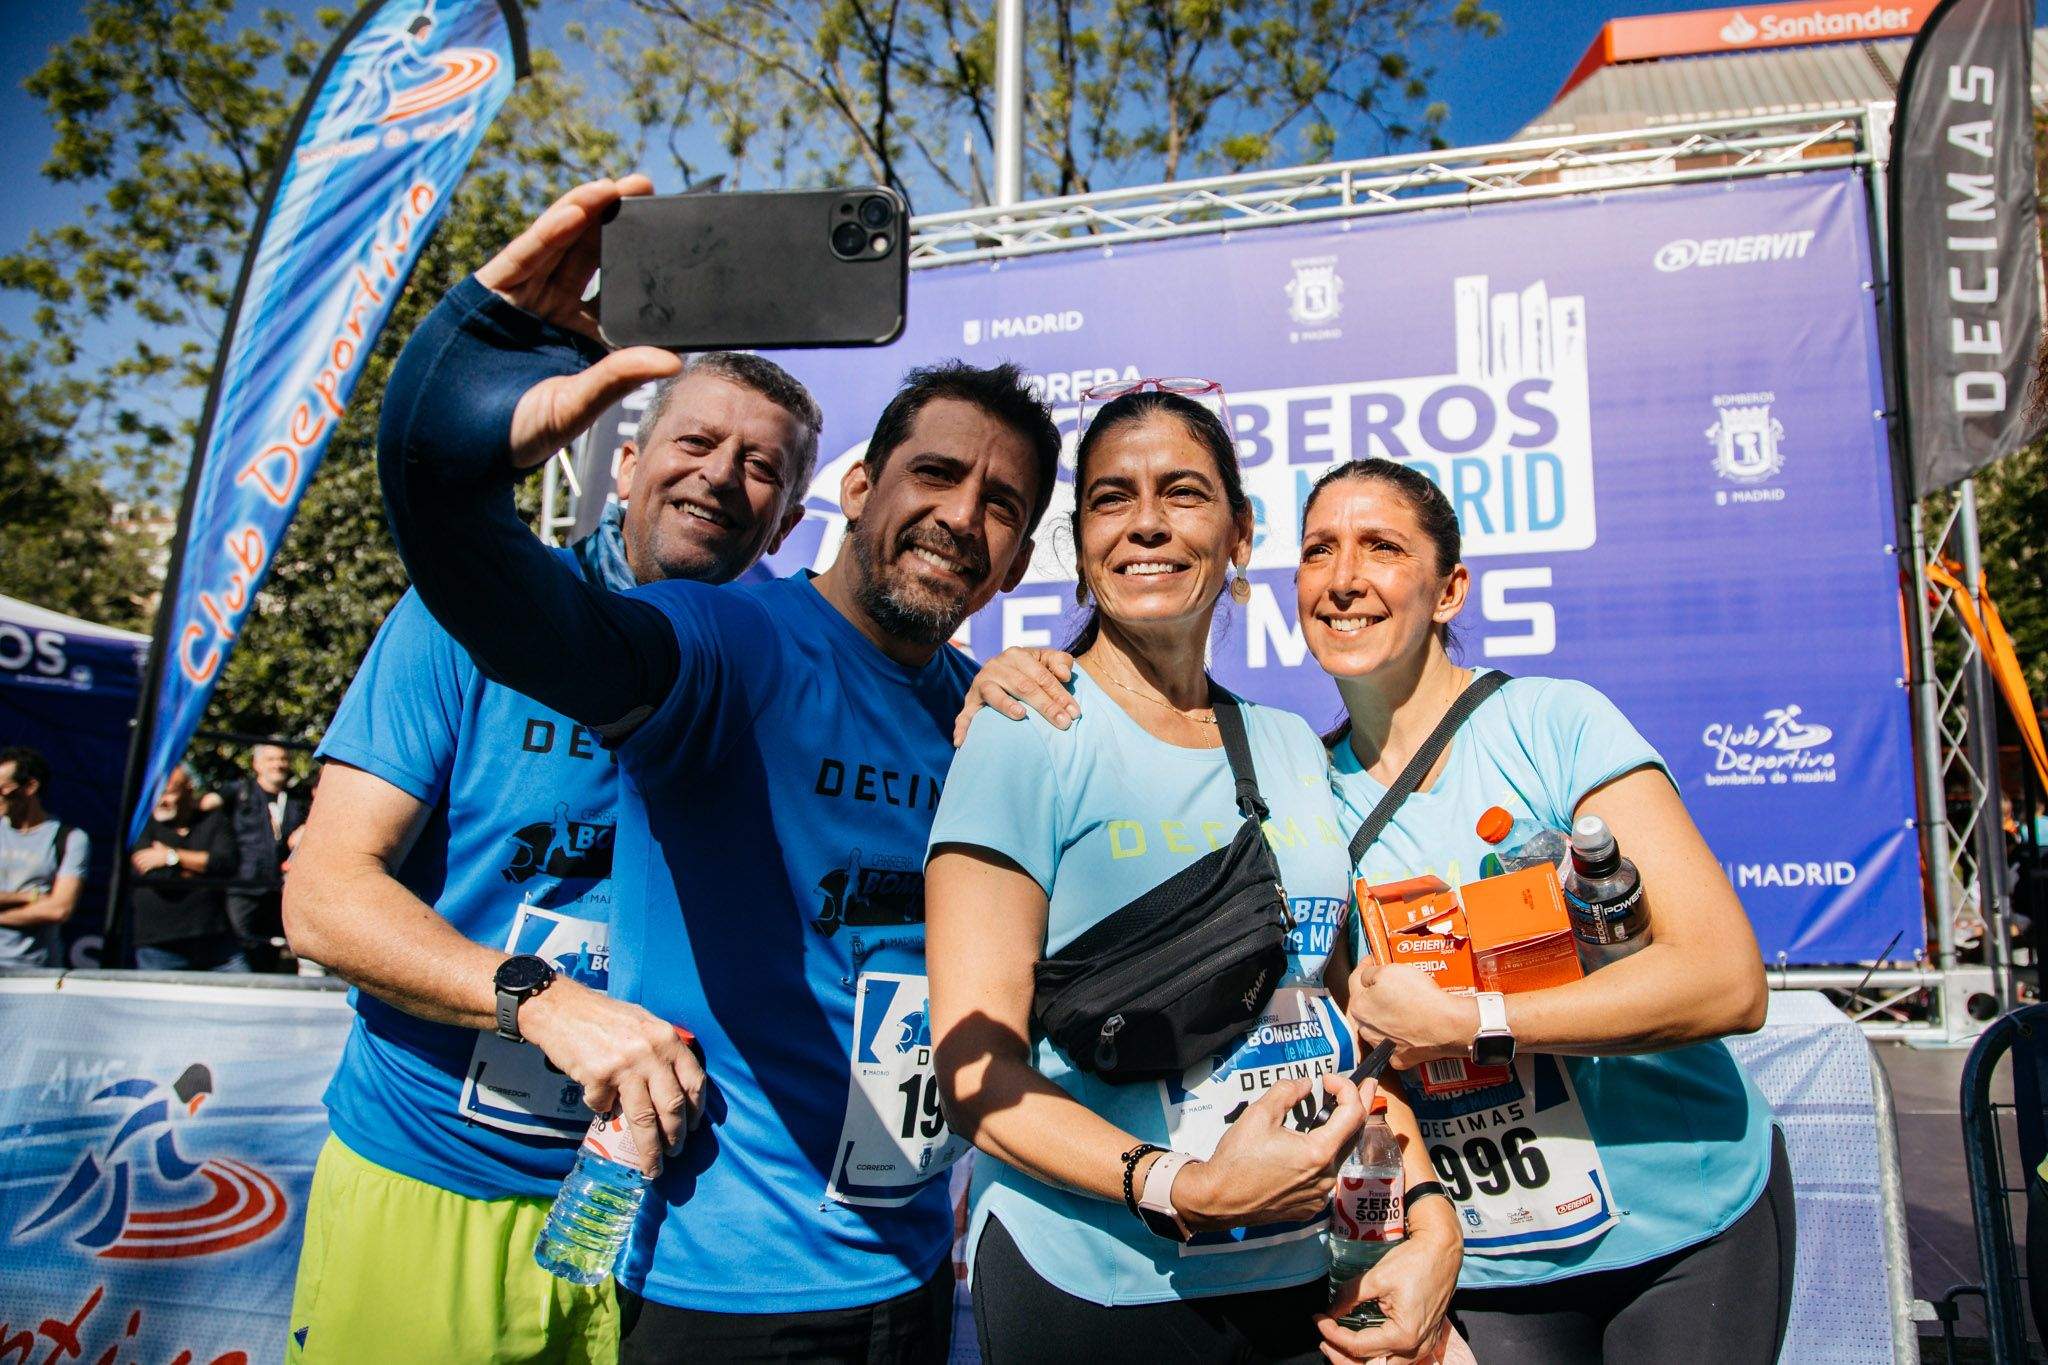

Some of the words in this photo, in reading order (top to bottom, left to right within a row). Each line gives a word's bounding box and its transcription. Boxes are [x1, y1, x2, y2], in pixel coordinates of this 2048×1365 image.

[1760, 6, 1913, 41] Santander
[1698, 229, 1816, 267] ENERVIT
[1946, 65, 2007, 413] DECIMAS
[990, 310, 1084, 339] MADRID
[1732, 487, 1786, 504] MADRID
[180, 527, 266, 684] Club
[1703, 723, 1760, 748] Club
[1714, 747, 1836, 775] Deportivo
[1737, 860, 1857, 888] MADRID
[1246, 1021, 1323, 1048] BOMBEROS
[1420, 1102, 1525, 1139] DECIMAS
[1355, 1208, 1400, 1222] SODIO
[1357, 1196, 1400, 1211] ZERO
